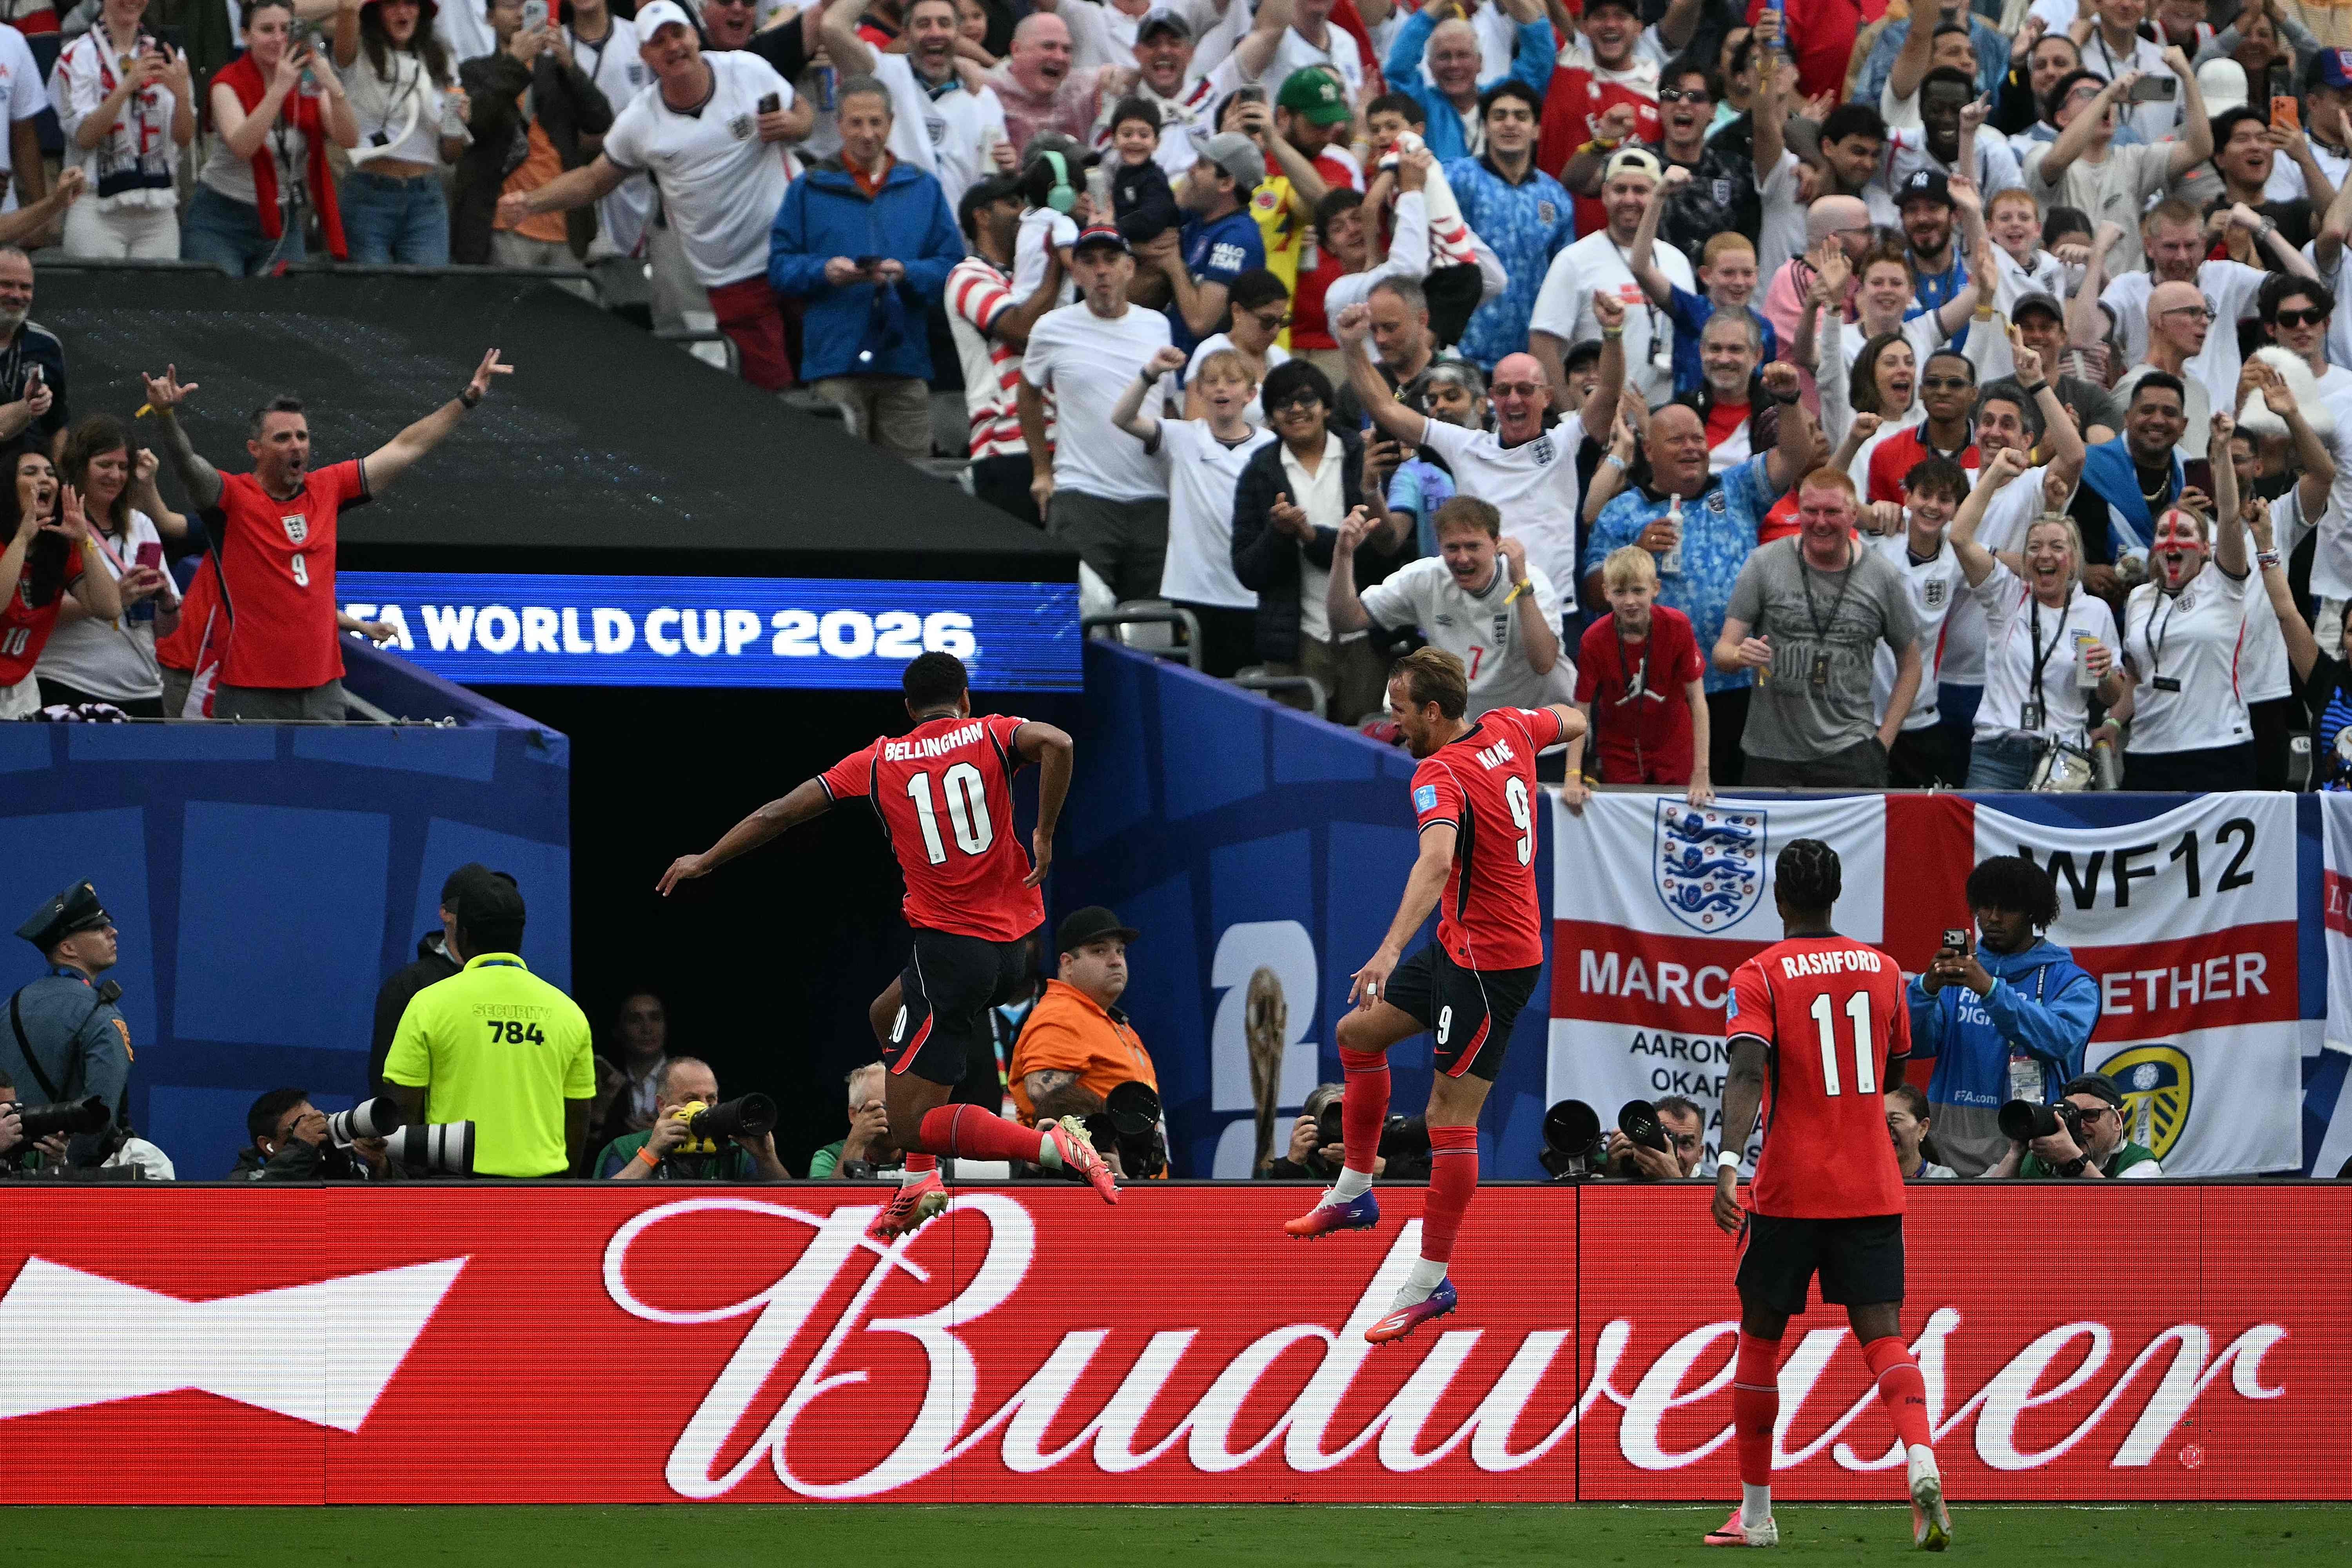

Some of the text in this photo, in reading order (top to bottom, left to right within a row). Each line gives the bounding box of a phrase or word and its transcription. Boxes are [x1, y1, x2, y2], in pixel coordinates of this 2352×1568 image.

[291, 554, 309, 587] 9
[1, 627, 31, 656] 10
[421, 604, 635, 654] WORLD
[644, 606, 762, 657] CUP
[771, 608, 976, 659] 2026
[1468, 646, 1484, 680] 7
[884, 722, 984, 761] BELLINGHAM
[1475, 738, 1514, 771] KANE
[907, 762, 993, 865] 10
[1505, 775, 1532, 867] 9
[2018, 817, 2256, 910] WF12
[1580, 949, 1729, 1009] MARC
[2102, 952, 2269, 1016] ETHER
[1781, 950, 1882, 979] RASHFORD
[472, 1003, 552, 1019] SECURITY
[888, 1004, 907, 1043] 0
[1437, 1005, 1452, 1045] 9
[487, 1020, 544, 1045] 784
[1630, 1031, 1730, 1063] AARON
[1810, 991, 1876, 1096] 11
[1651, 1068, 1726, 1098] OKAF
[603, 1192, 2291, 1497] Budweiser
